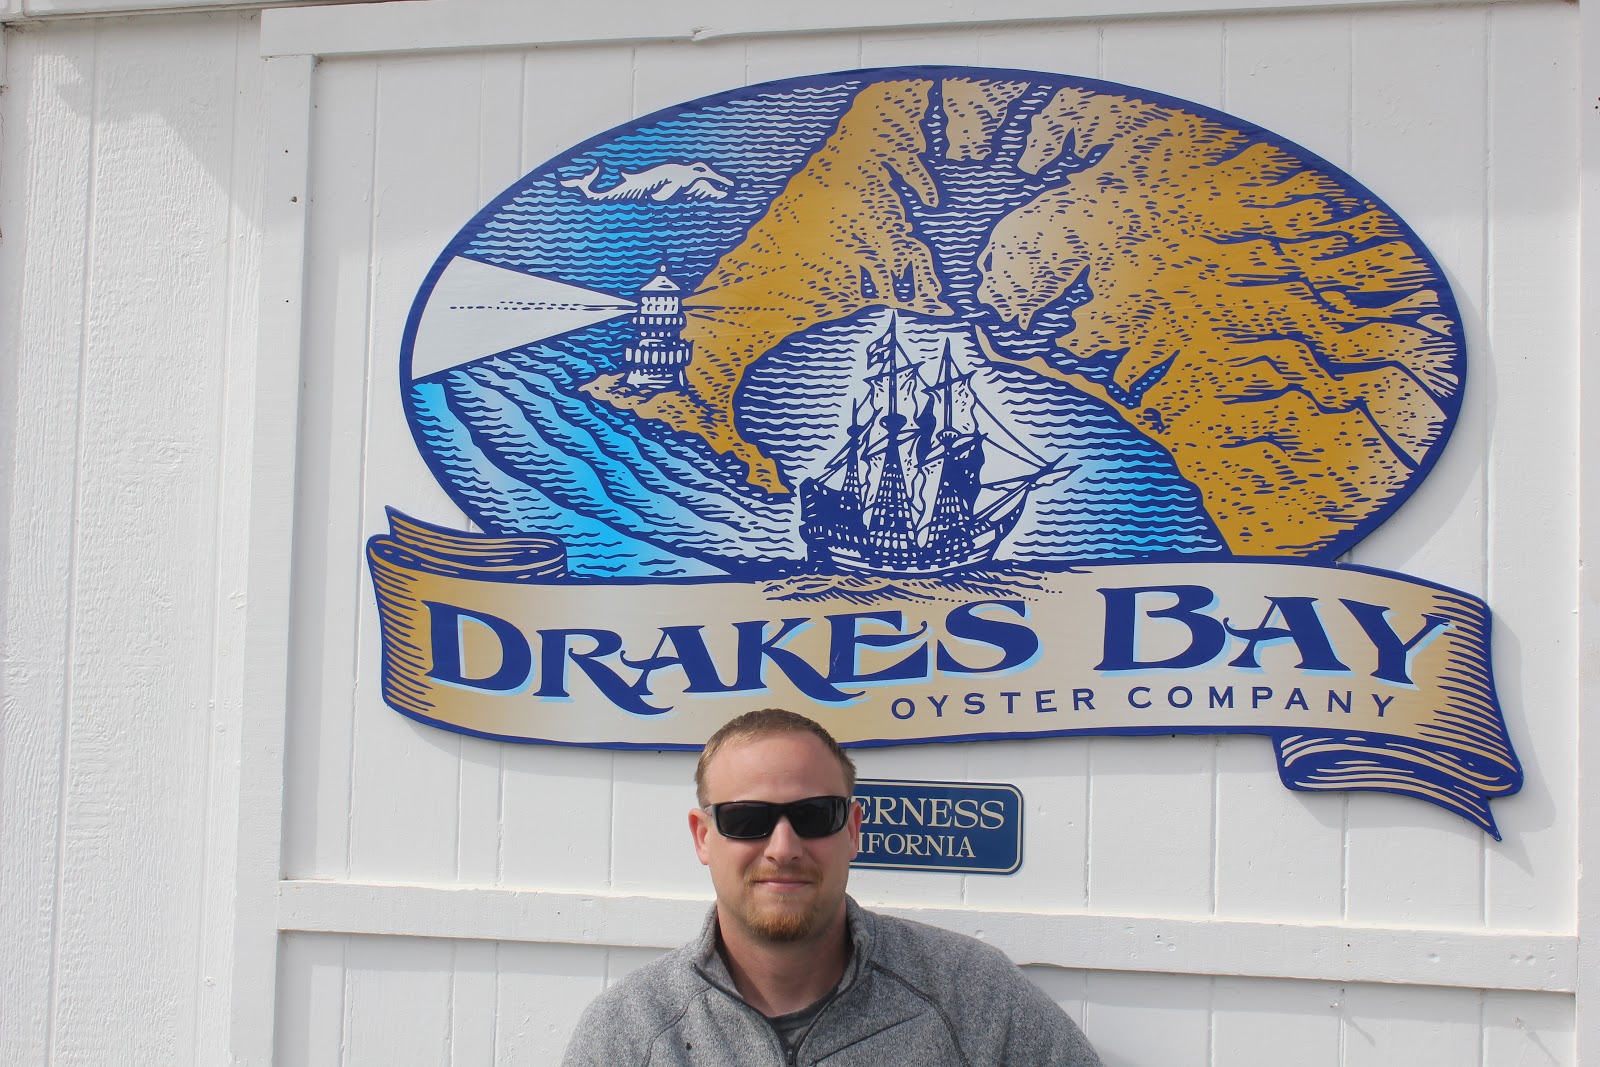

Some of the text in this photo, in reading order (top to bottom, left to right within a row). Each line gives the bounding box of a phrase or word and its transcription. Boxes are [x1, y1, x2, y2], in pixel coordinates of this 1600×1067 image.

[422, 584, 1455, 715] DRAKES BAY
[892, 685, 1395, 719] OYSTER COMPANY
[857, 832, 977, 859] IFORNIA
